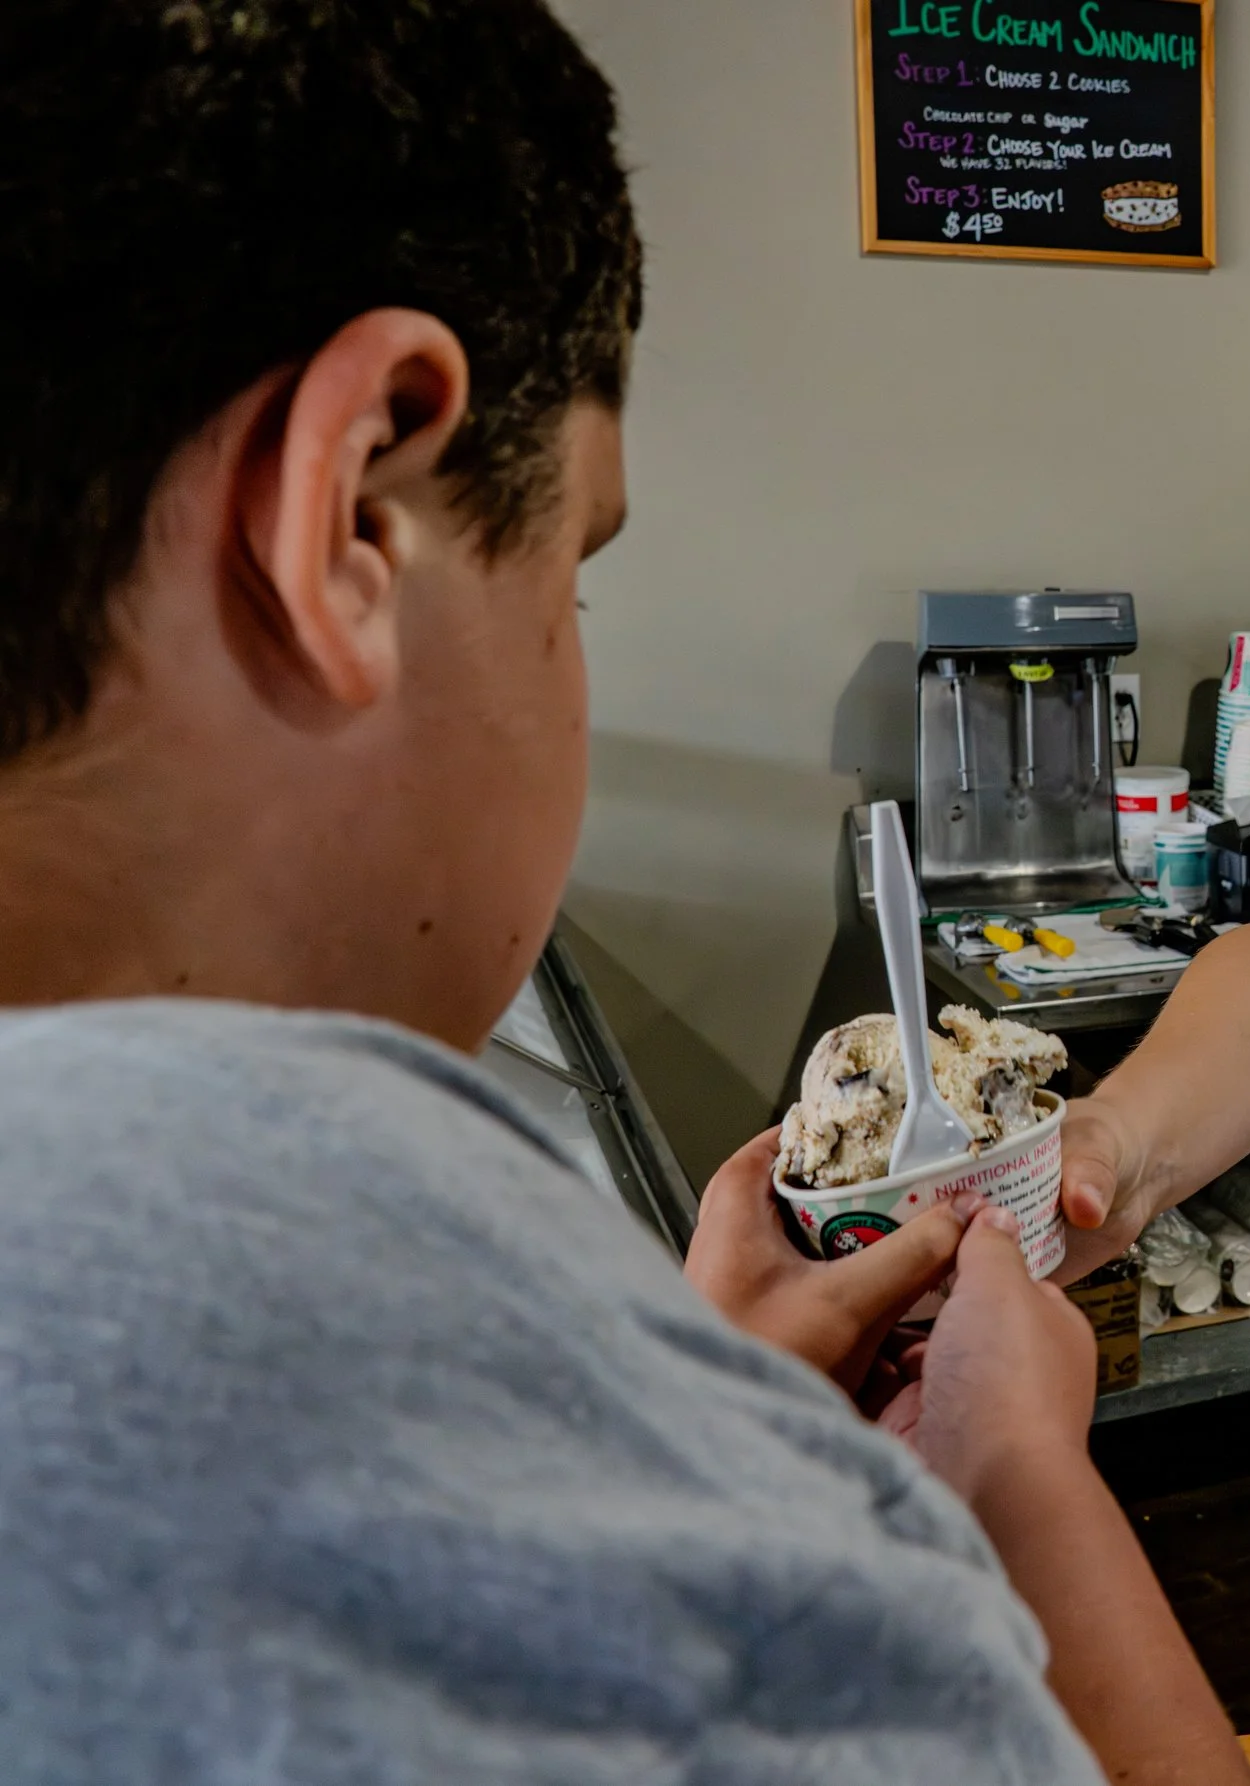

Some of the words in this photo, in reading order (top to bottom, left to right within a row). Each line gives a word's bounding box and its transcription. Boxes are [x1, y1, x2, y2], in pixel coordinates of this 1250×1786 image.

[888, 0, 962, 38] ICE
[971, 0, 1063, 53] CREAM
[1073, 1, 1196, 70] SANDWICH
[894, 52, 951, 83] STEP
[985, 64, 1042, 89] CHOOSE
[1048, 71, 1062, 90] 2
[1067, 72, 1131, 94] COOKIES
[897, 120, 957, 153] STEP
[986, 134, 1044, 157] CHOOSE
[1046, 140, 1087, 161] YOUR
[1120, 138, 1172, 160] CREAM
[960, 157, 991, 170] HAVE
[904, 175, 960, 208] STEP
[991, 186, 1064, 214] ENJOY!
[934, 1151, 1031, 1200] NUTRITIONAL
